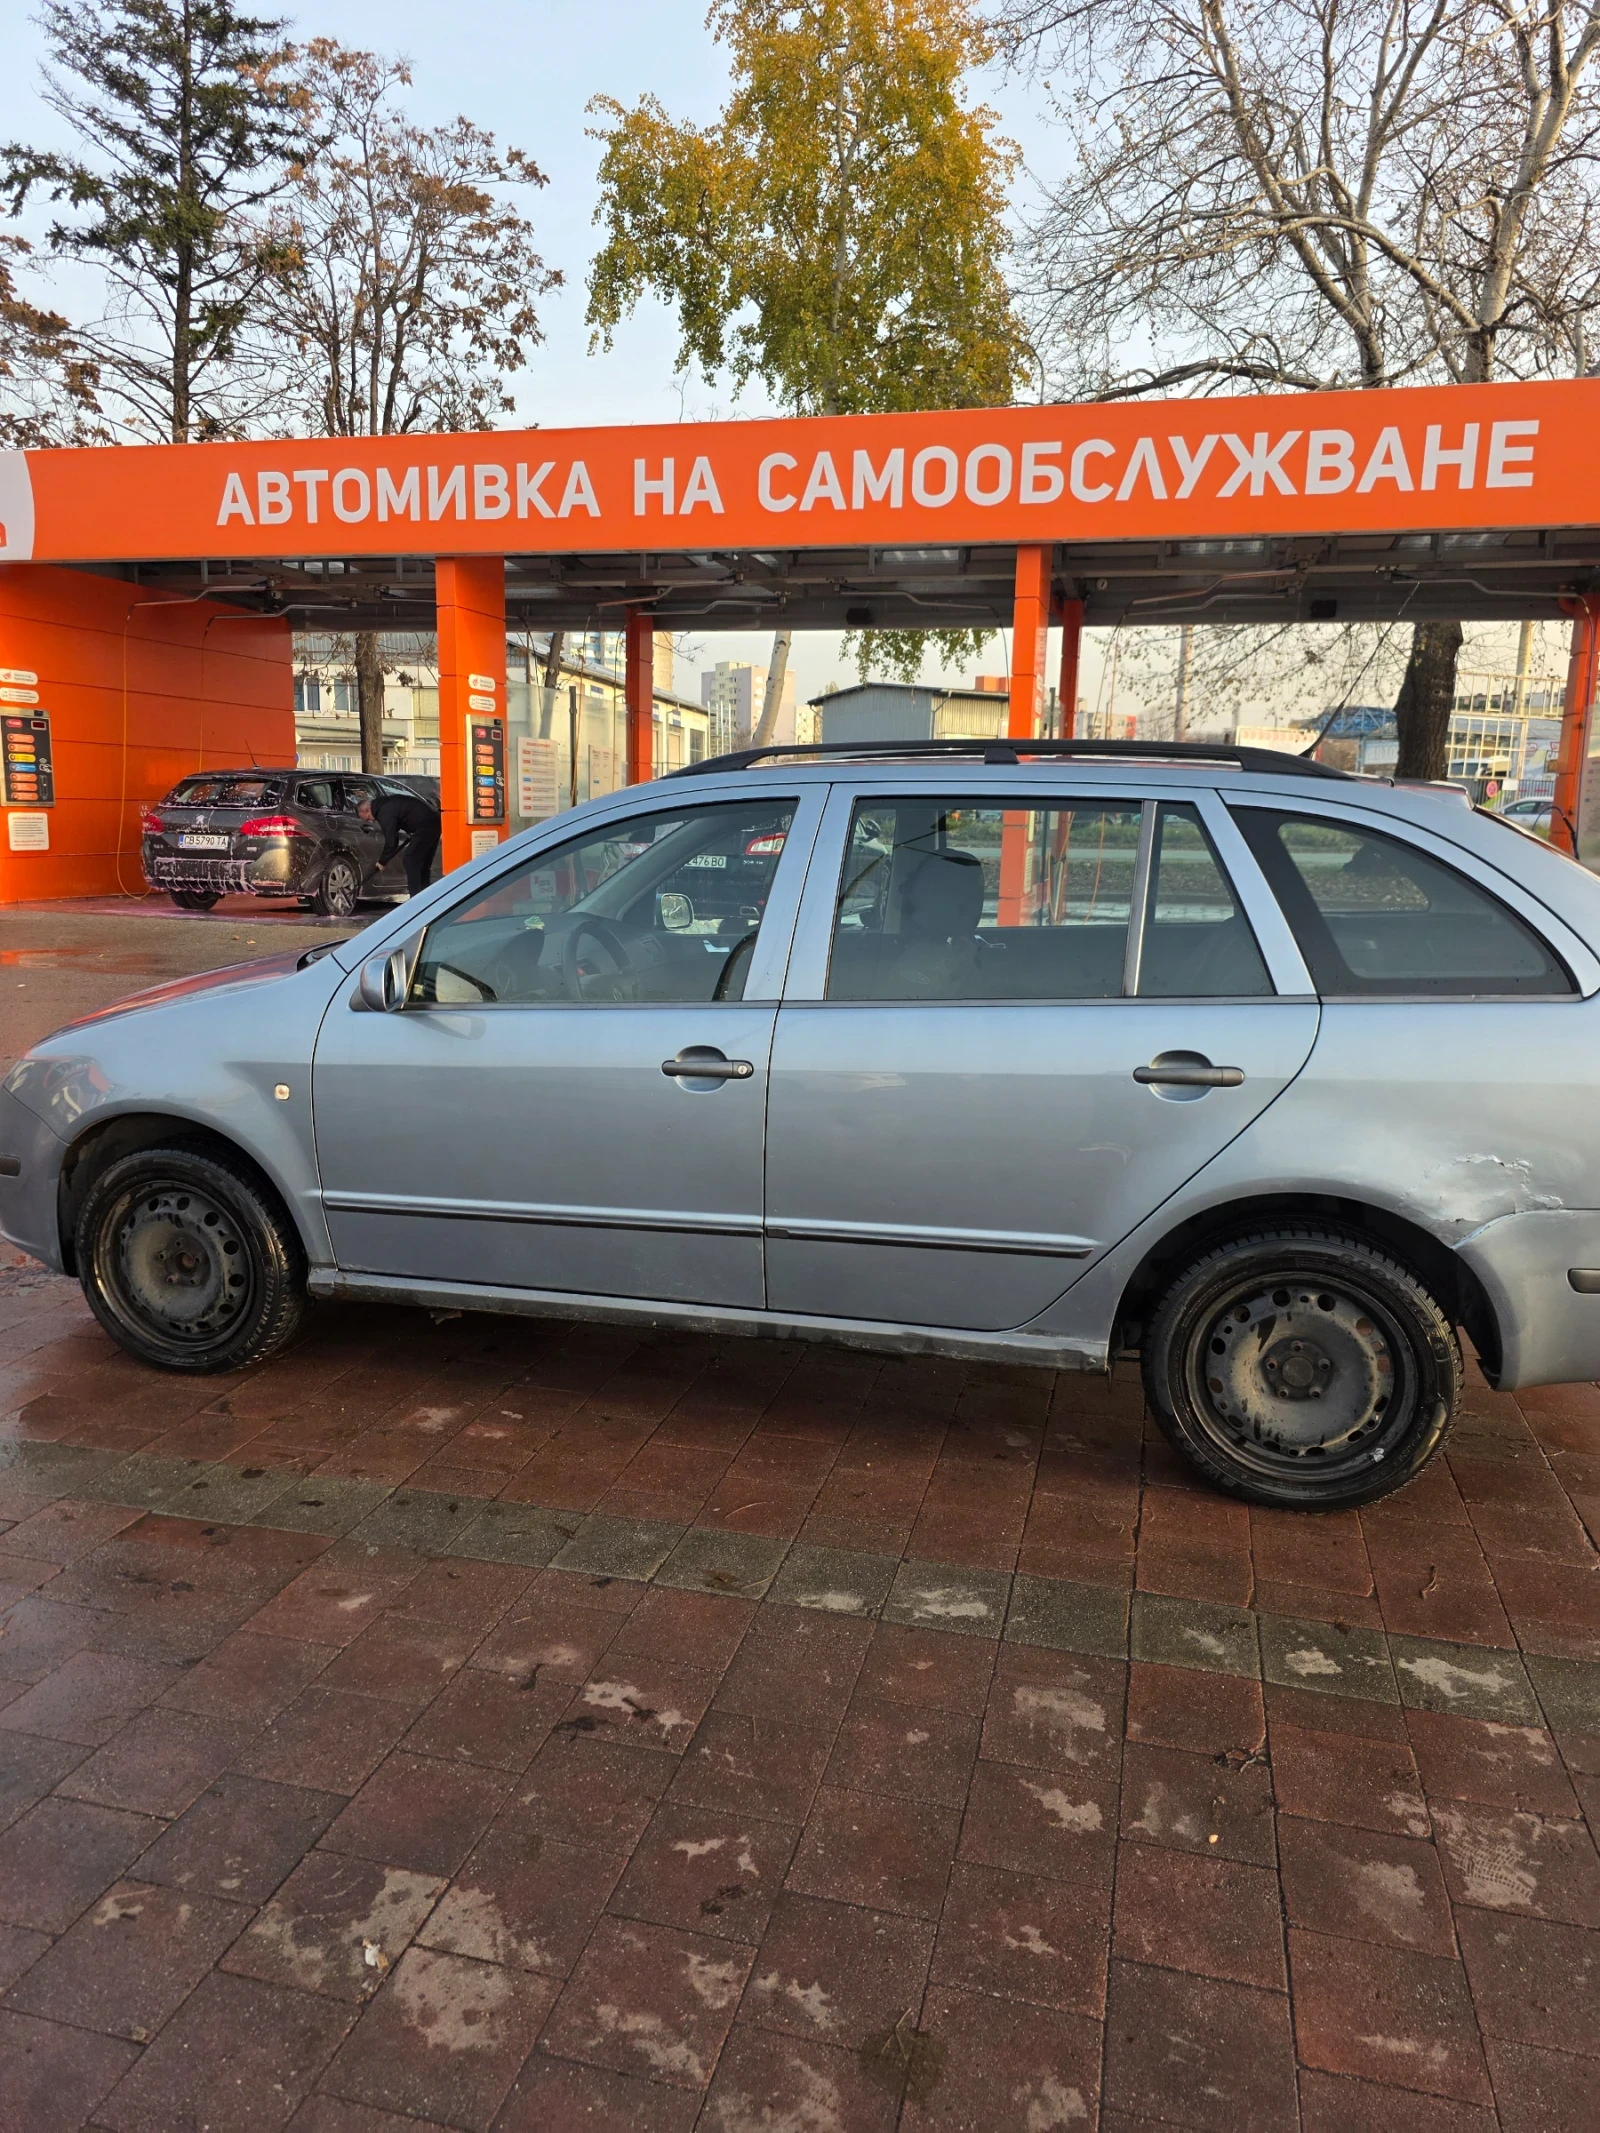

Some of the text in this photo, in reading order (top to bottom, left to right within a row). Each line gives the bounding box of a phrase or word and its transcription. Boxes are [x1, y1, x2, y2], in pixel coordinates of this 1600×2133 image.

[217, 420, 1540, 525] АВТОМИВКА НА САМООБСЛУЖВАНЕ
[195, 836, 215, 845] 5790
[217, 836, 227, 846] TA
